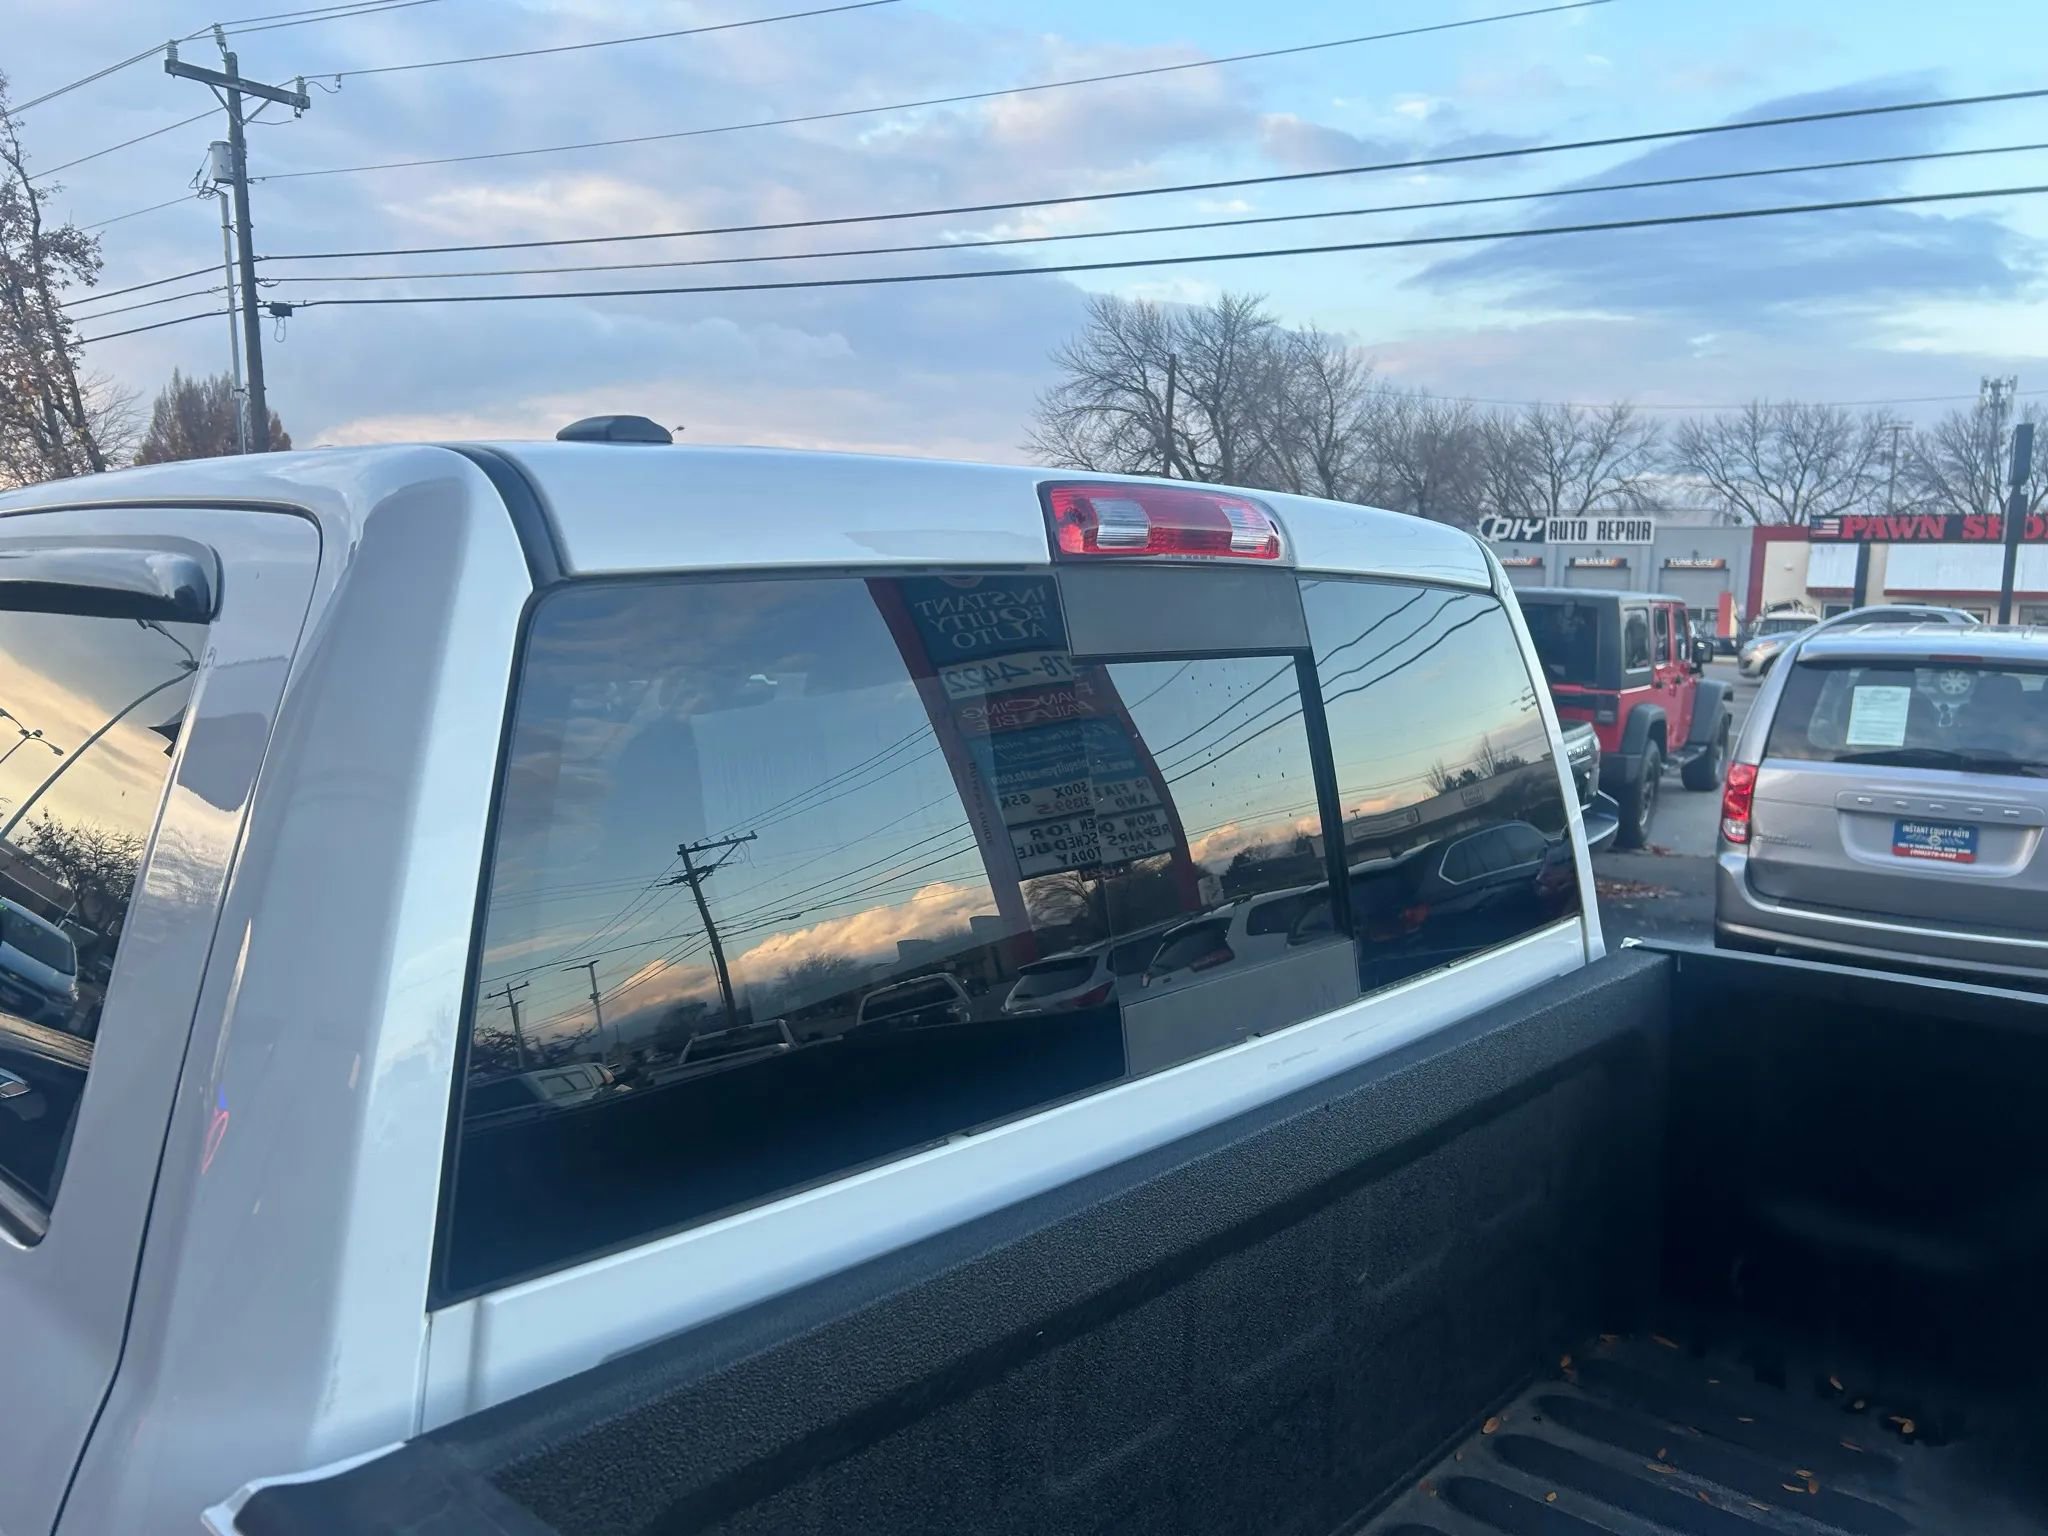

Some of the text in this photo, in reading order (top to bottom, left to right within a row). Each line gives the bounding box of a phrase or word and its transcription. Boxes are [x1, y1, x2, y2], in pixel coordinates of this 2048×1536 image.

[1490, 517, 1653, 542] DIY AUTO REPAIR
[1840, 515, 2048, 540] PAWN SO
[1902, 824, 1929, 834] INSTANT
[1953, 827, 1970, 838] AUTO
